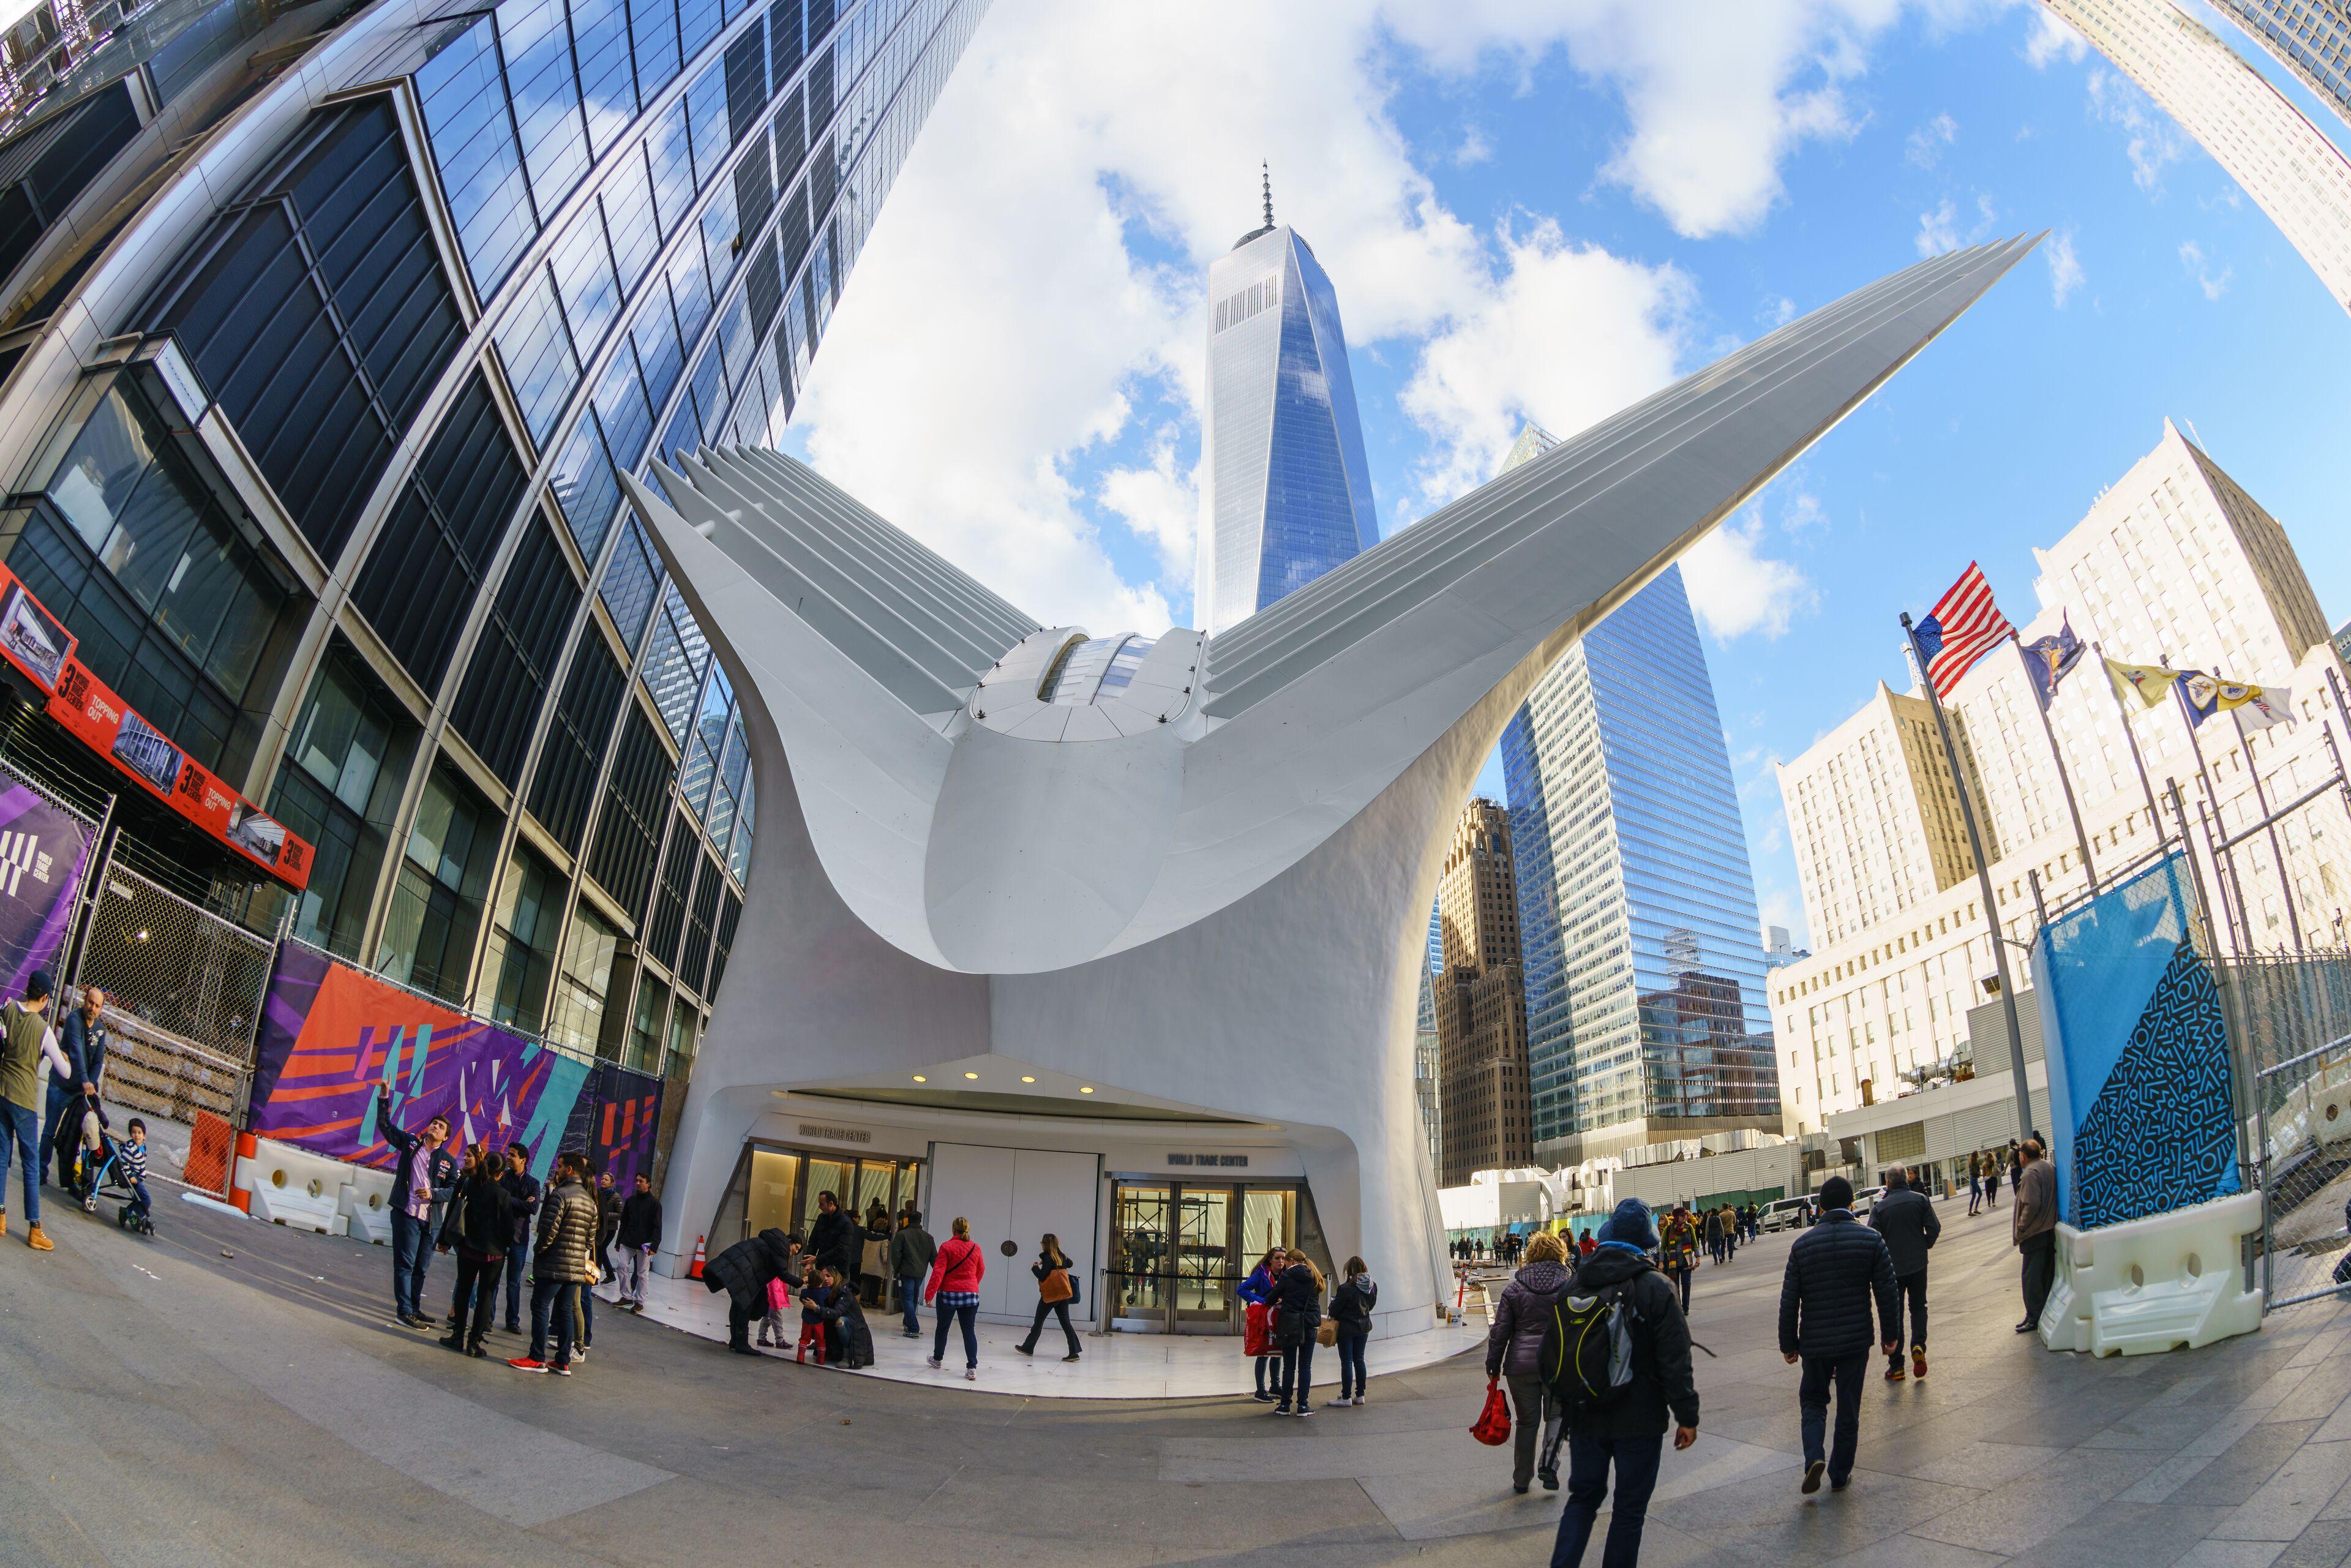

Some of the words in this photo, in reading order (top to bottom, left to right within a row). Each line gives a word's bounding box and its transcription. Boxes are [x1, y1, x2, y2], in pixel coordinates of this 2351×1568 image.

[58, 664, 76, 698] 3
[88, 706, 103, 724] OUT
[92, 694, 119, 724] TOPPING
[179, 764, 193, 793] 3
[204, 799, 218, 812] OUT
[208, 787, 231, 811] TOPPING
[38, 850, 53, 866] WORLD
[283, 839, 294, 865] 3
[33, 868, 50, 883] CENTER
[36, 860, 50, 874] TRADE
[799, 1124, 821, 1137] WORLD
[823, 1127, 844, 1140] TRADE
[845, 1130, 871, 1143] CENTER
[1168, 1153, 1193, 1166] WORLD
[1196, 1154, 1218, 1166] TRADE
[1220, 1155, 1248, 1167] CENTER
